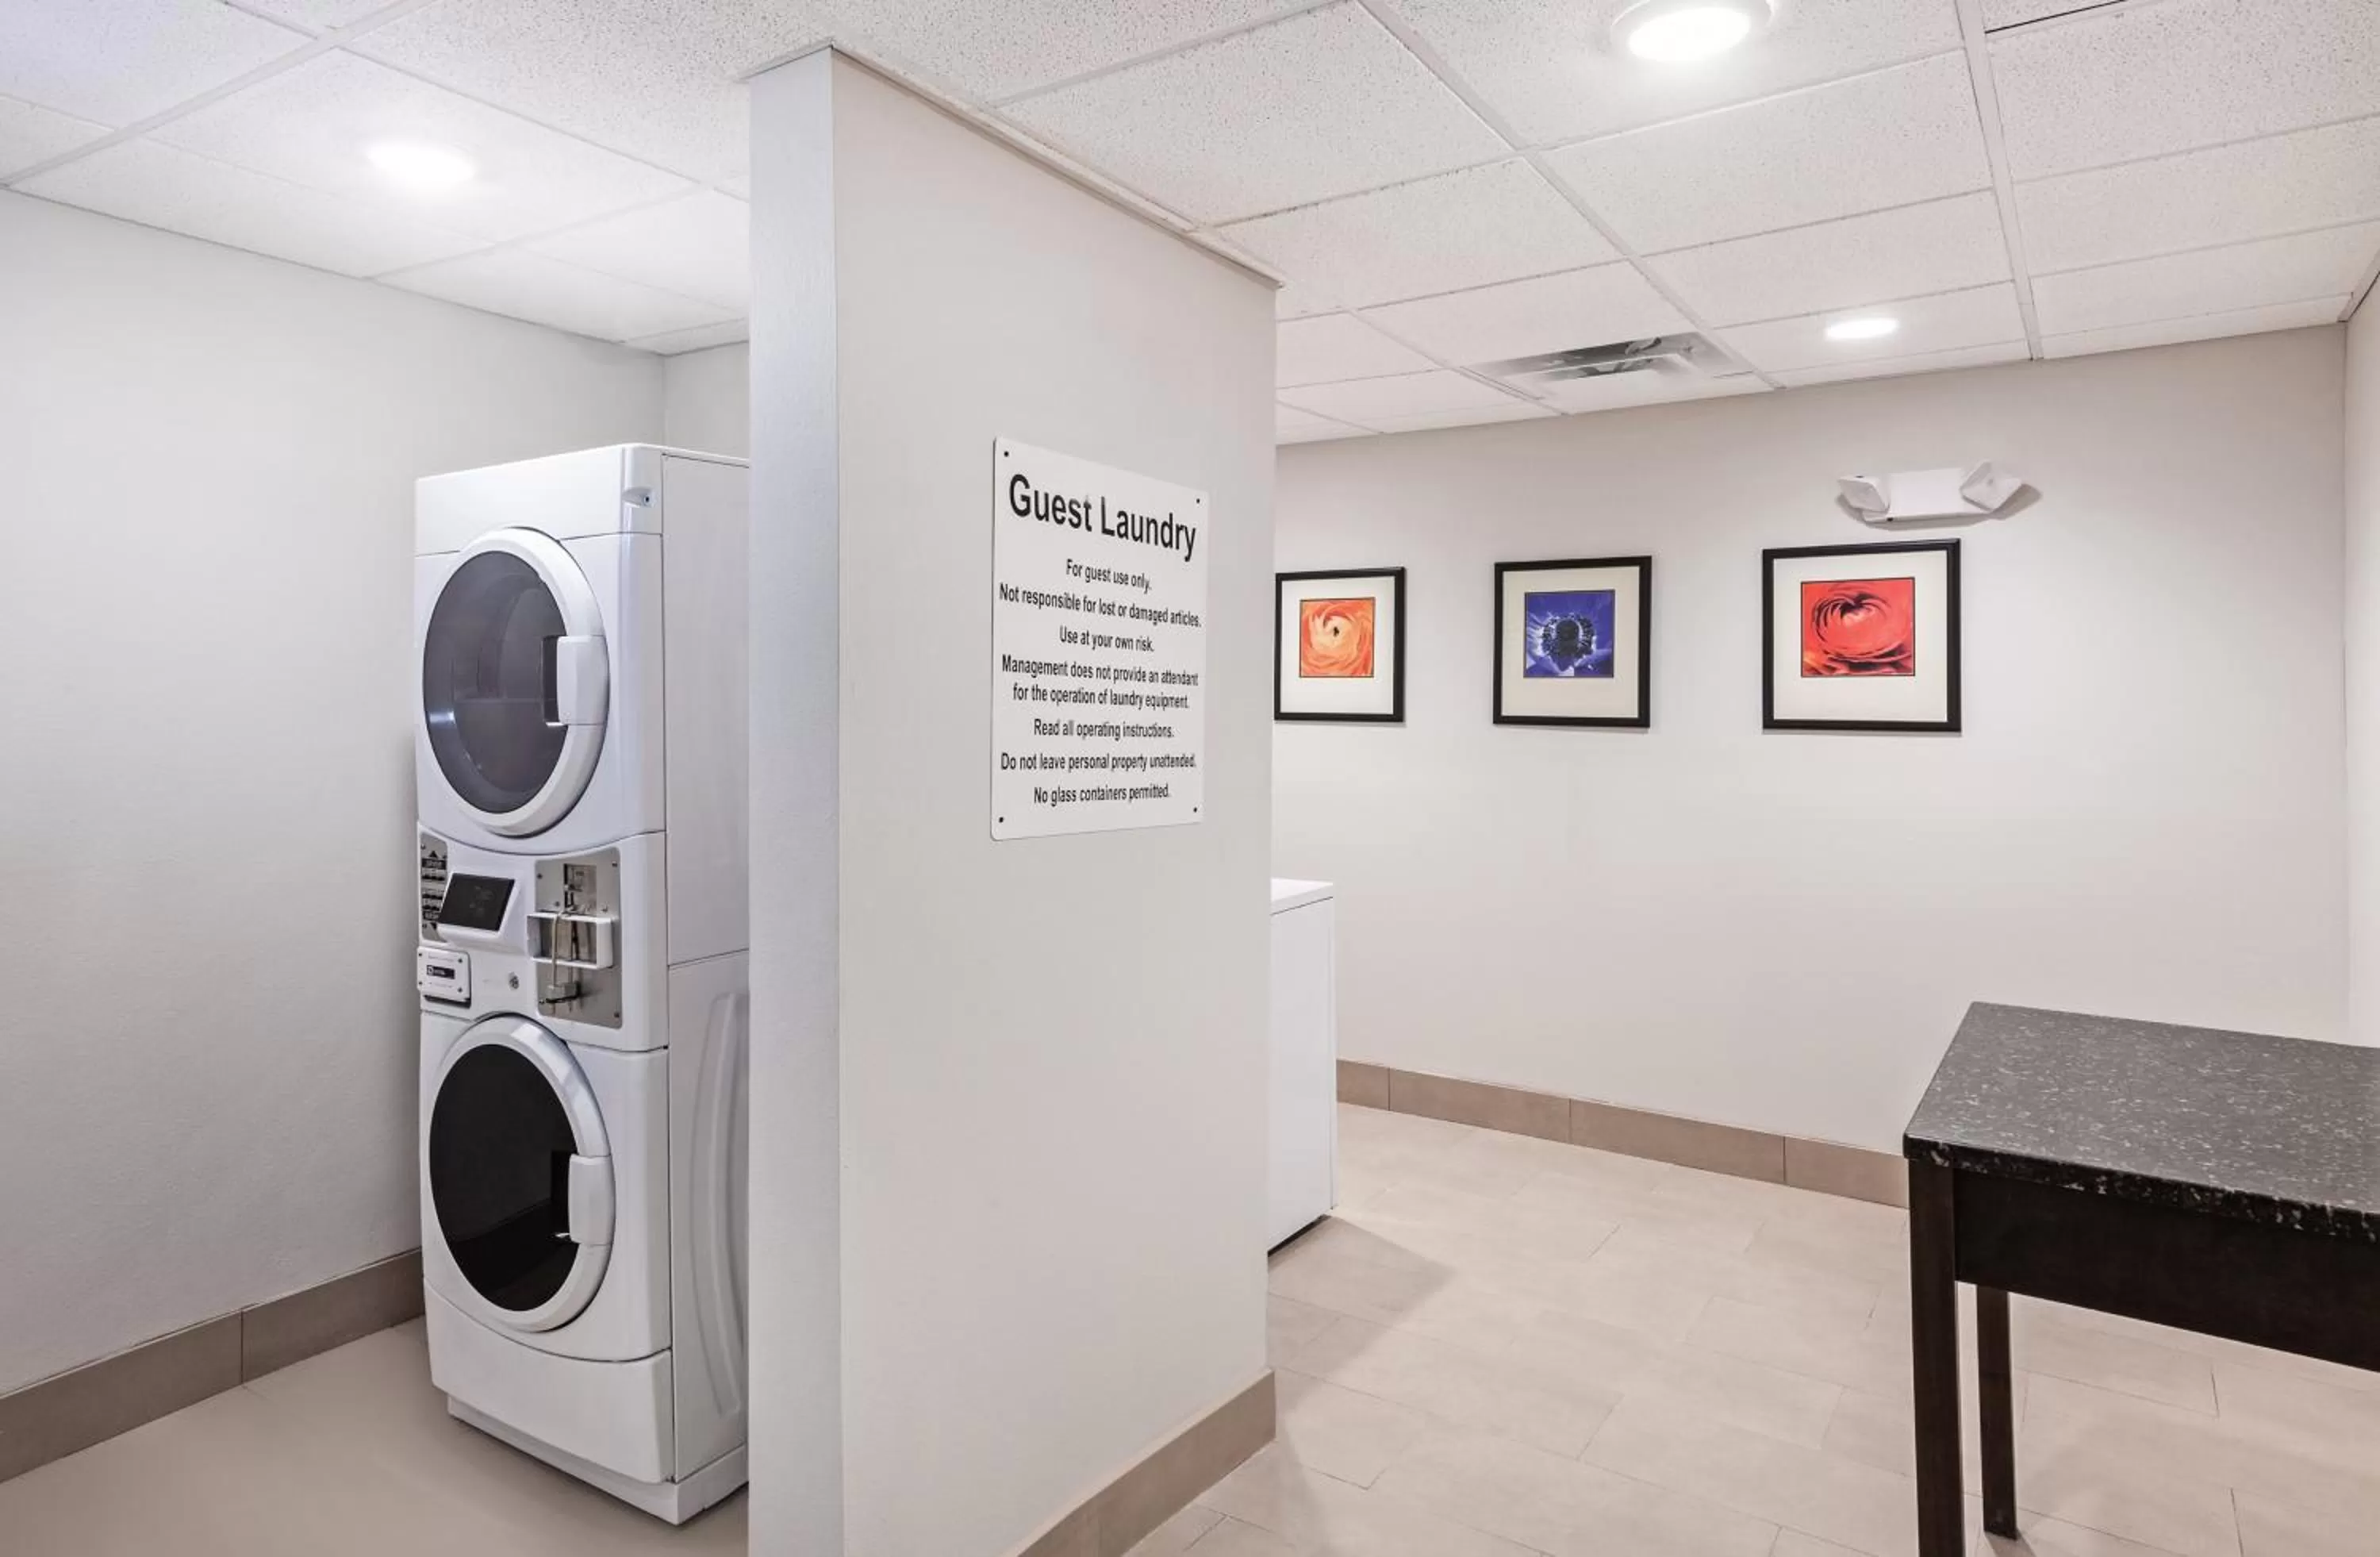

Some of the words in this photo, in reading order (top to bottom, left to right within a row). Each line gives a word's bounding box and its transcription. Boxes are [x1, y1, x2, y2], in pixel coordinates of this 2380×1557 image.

[1008, 473, 1092, 532] Guest
[1100, 495, 1196, 563] Laundry
[1065, 558, 1084, 579] For
[1084, 566, 1111, 584] guest
[1113, 571, 1130, 586] use
[1130, 572, 1152, 594] only.
[999, 582, 1019, 603] Not
[1021, 590, 1081, 612] responsible
[1082, 594, 1097, 613] for
[1098, 598, 1116, 617] lost
[1117, 605, 1128, 617] or
[1128, 602, 1169, 626] damaged
[1169, 609, 1202, 628] articles.
[1059, 625, 1079, 644] Use
[1080, 629, 1090, 646] at
[1091, 634, 1114, 651] your
[1115, 636, 1134, 651] own
[1135, 636, 1155, 652] risk.
[1002, 653, 1069, 679] Management
[1070, 660, 1094, 679] does
[1096, 665, 1111, 680] not
[1113, 666, 1147, 685] provide
[1148, 671, 1159, 683] an
[1161, 669, 1199, 686] attendant
[1012, 682, 1030, 701] for
[1031, 683, 1048, 702] the
[1050, 686, 1096, 707] operation
[1097, 688, 1108, 705] of
[1110, 688, 1144, 711] laundry
[1034, 717, 1061, 736] Read
[1062, 720, 1074, 736] all
[1076, 721, 1121, 742] operating
[1123, 721, 1175, 739] instructions.
[1000, 752, 1017, 771] Do
[1019, 753, 1038, 771] not
[1038, 752, 1066, 771] leave
[1068, 752, 1110, 773] personal
[1111, 753, 1148, 772] property
[1034, 786, 1049, 804] No
[1050, 785, 1077, 808] glass
[1079, 784, 1127, 802] containers
